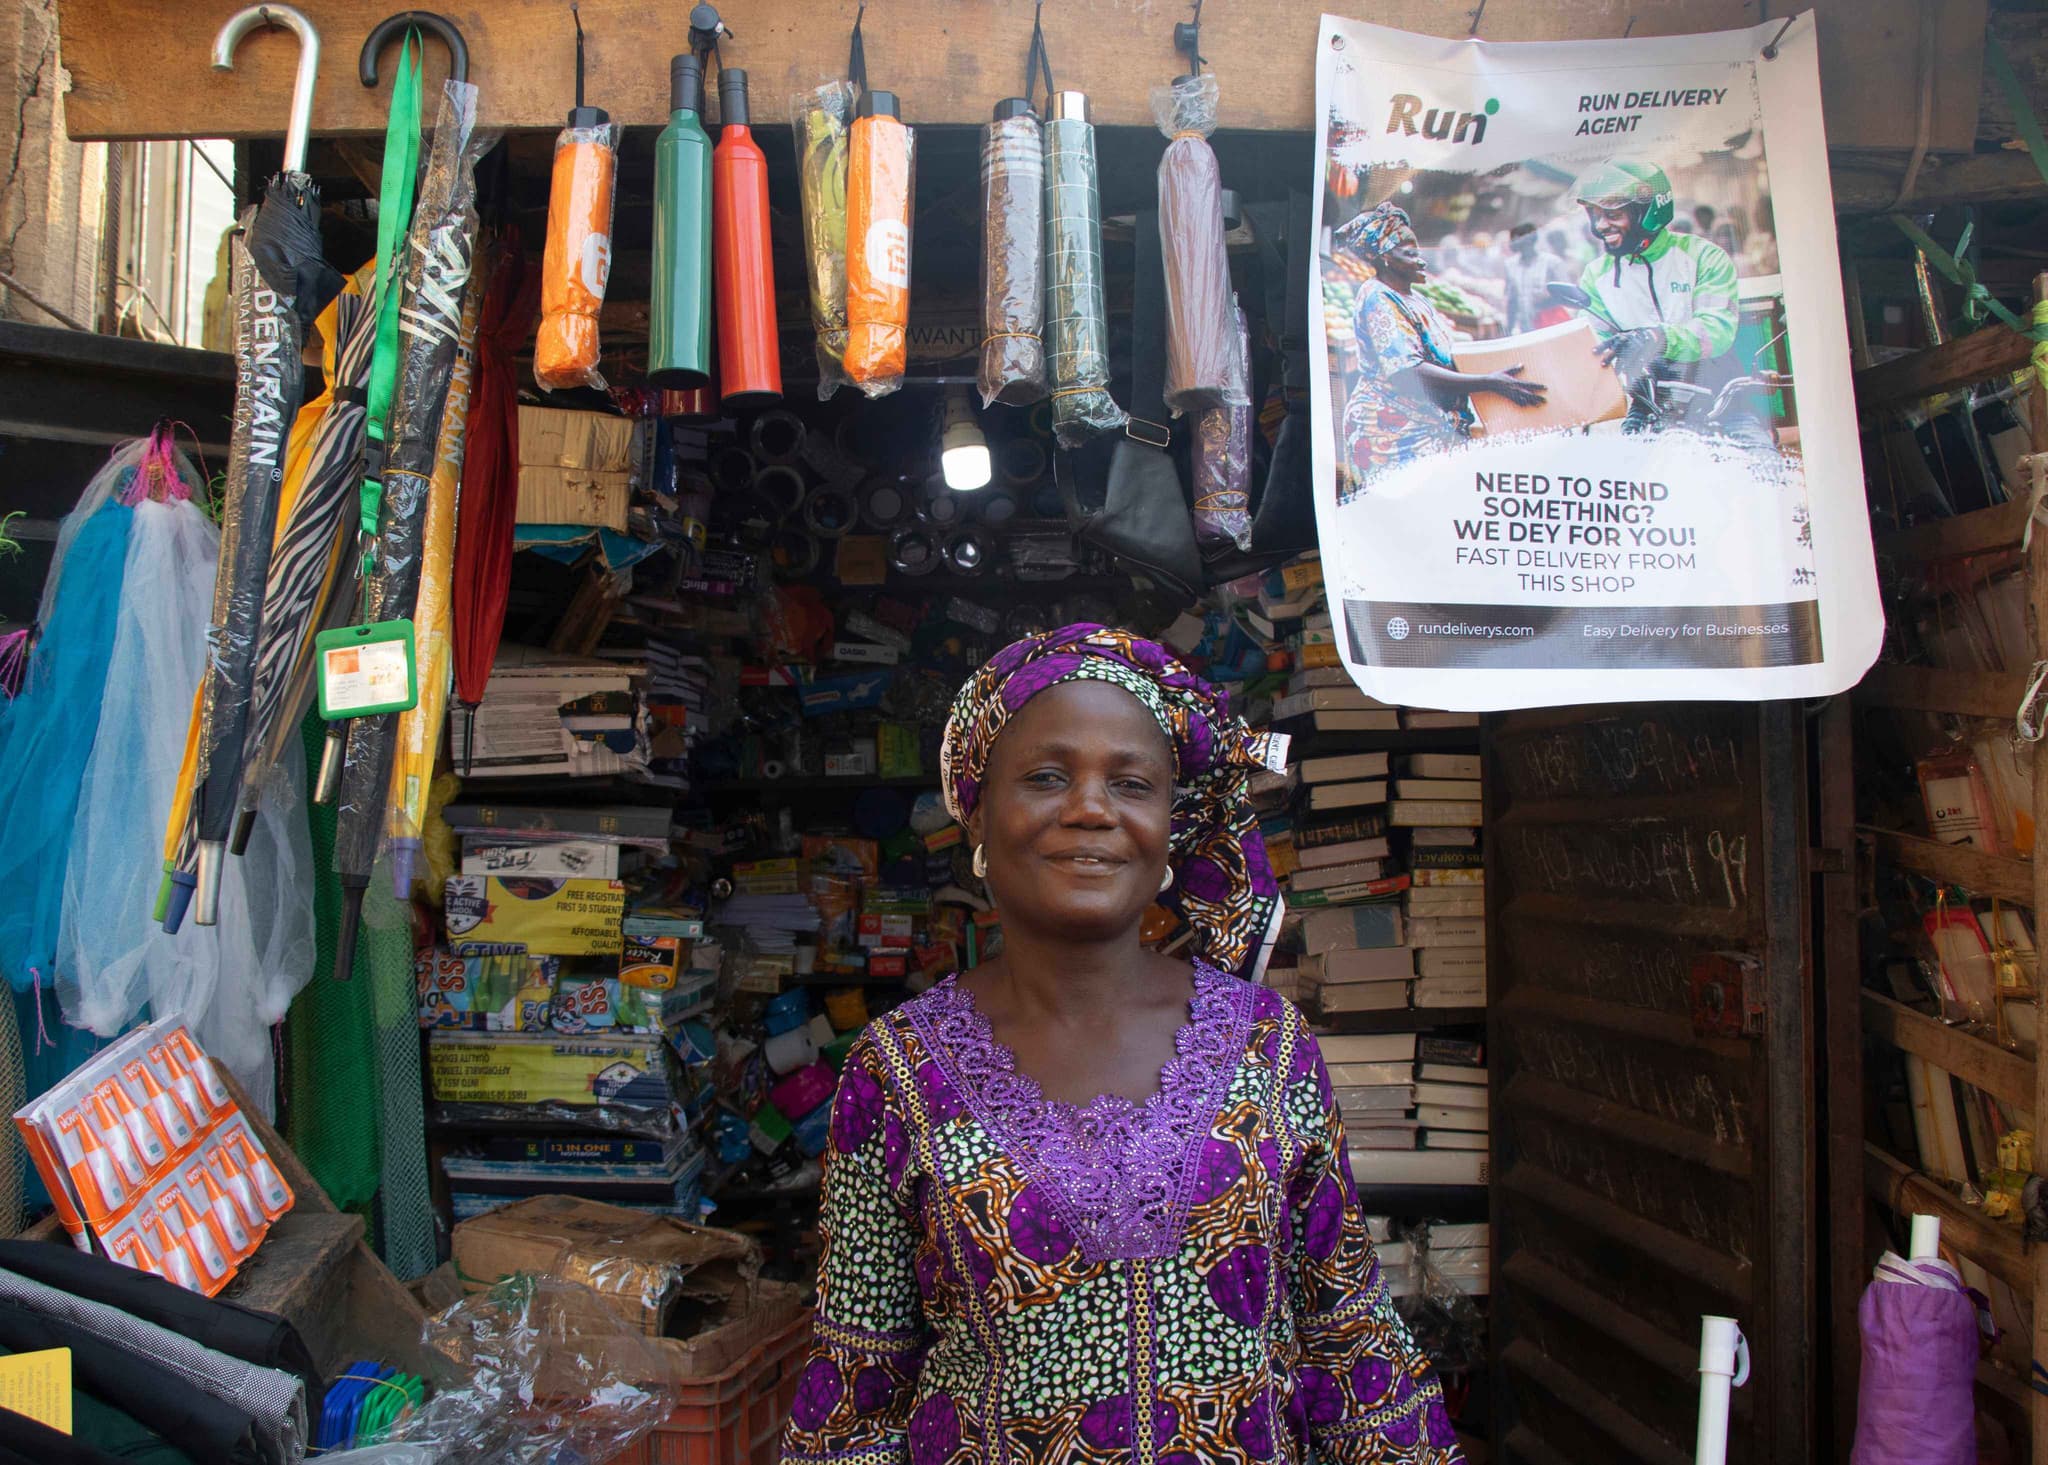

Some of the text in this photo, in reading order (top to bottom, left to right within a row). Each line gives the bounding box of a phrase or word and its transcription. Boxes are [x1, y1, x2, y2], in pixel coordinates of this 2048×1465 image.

[1578, 88, 1727, 113] RUN DELIVERY
[1386, 94, 1488, 145] Run
[1575, 115, 1642, 137] AGENT
[1671, 282, 1691, 293] Run
[233, 331, 252, 433] UMBRELLA
[444, 389, 470, 466] RAIN
[1476, 472, 1669, 502] NEED TO SEND
[1484, 496, 1655, 524] SOMETHING?
[1453, 519, 1697, 547] WE DEY FOR YOU!
[1456, 547, 1696, 570] FAST DELIVERY FROM
[1517, 573, 1635, 593] THIS SHOP
[1418, 622, 1790, 640] rundeliverys.com Easy Delivery for Businesses
[567, 890, 585, 900] FREE
[571, 928, 618, 938] AFFORDABLE
[564, 1144, 581, 1152] IN
[584, 1144, 612, 1152] ONE
